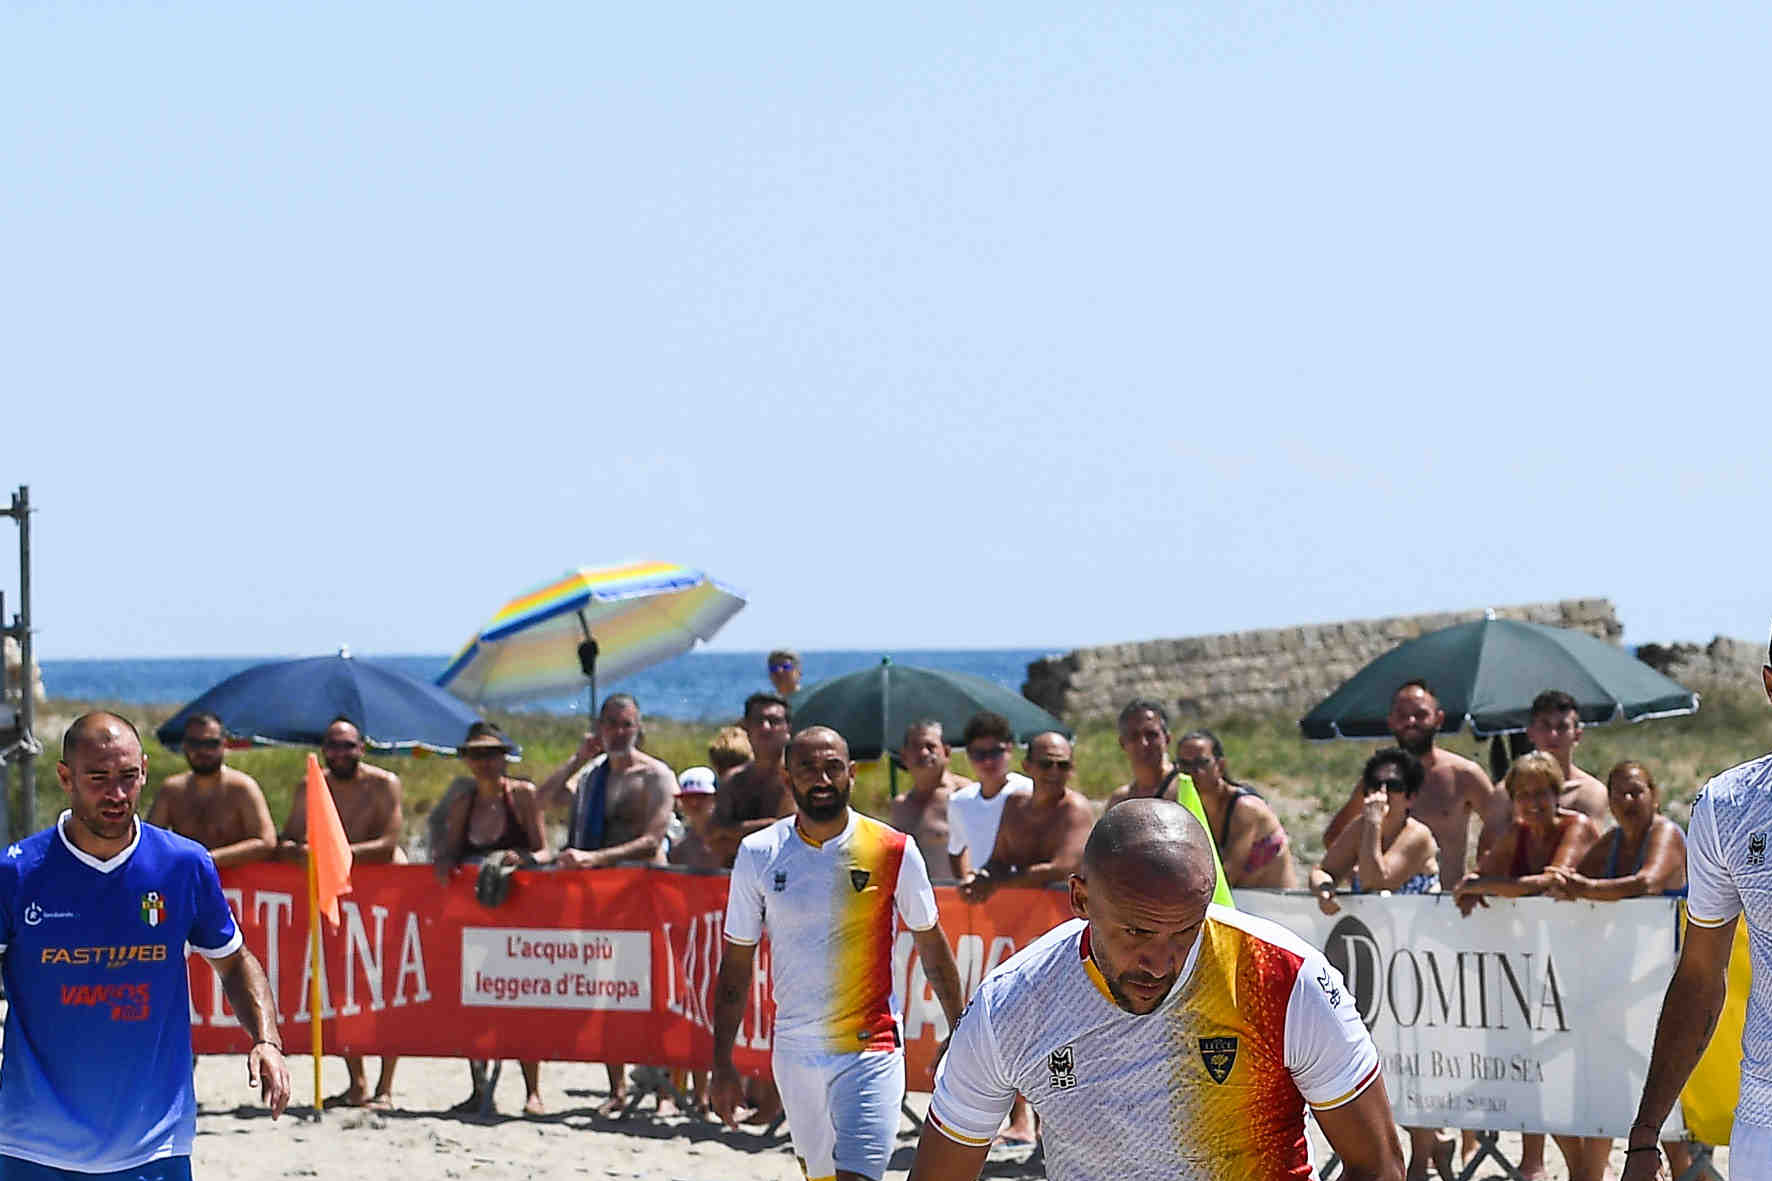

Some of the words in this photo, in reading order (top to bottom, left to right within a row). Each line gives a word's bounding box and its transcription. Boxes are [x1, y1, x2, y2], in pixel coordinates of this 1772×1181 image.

[507, 936, 579, 964] L'acqua
[583, 937, 613, 965] più
[476, 971, 552, 1000] leggera
[556, 972, 640, 1002] d'Europa
[1340, 934, 1572, 1032] DOMINA
